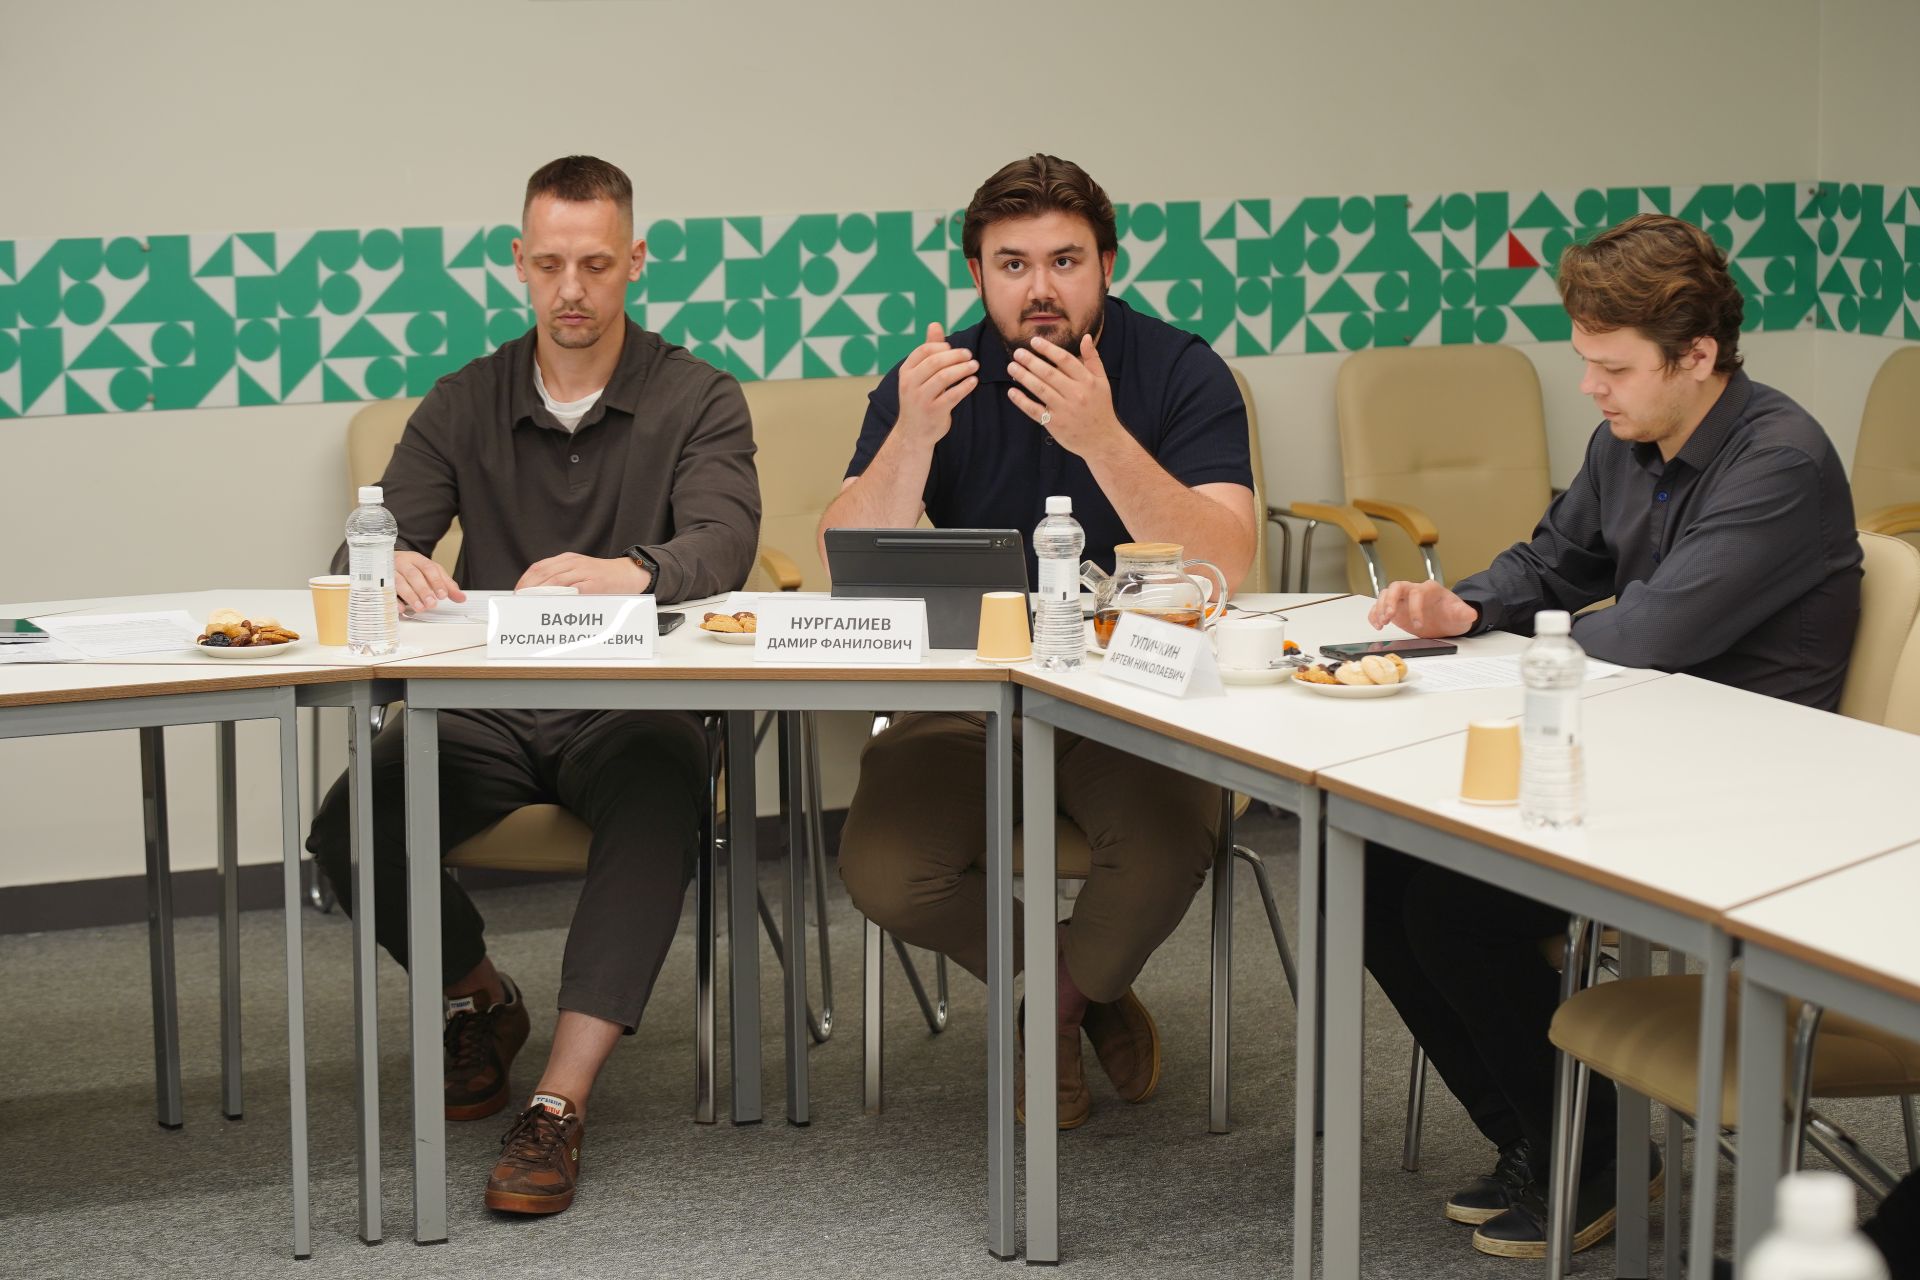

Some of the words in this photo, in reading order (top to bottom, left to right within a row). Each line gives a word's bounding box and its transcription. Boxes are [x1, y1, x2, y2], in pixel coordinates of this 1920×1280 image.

[540, 613, 604, 626] ВАФИН
[790, 617, 892, 631] НУРГАЛИЕВ
[500, 634, 555, 645] РУСЛАН
[558, 634, 644, 645] ВАСЕВИЧ
[767, 637, 818, 649] ДАМИР
[820, 637, 912, 650] ФАНИЛОВИЧ
[1130, 634, 1181, 659] ТУПИЧКИН
[1110, 652, 1134, 667] АРТЕМ
[1134, 659, 1186, 682] НИКОЛАЕВИЧ
